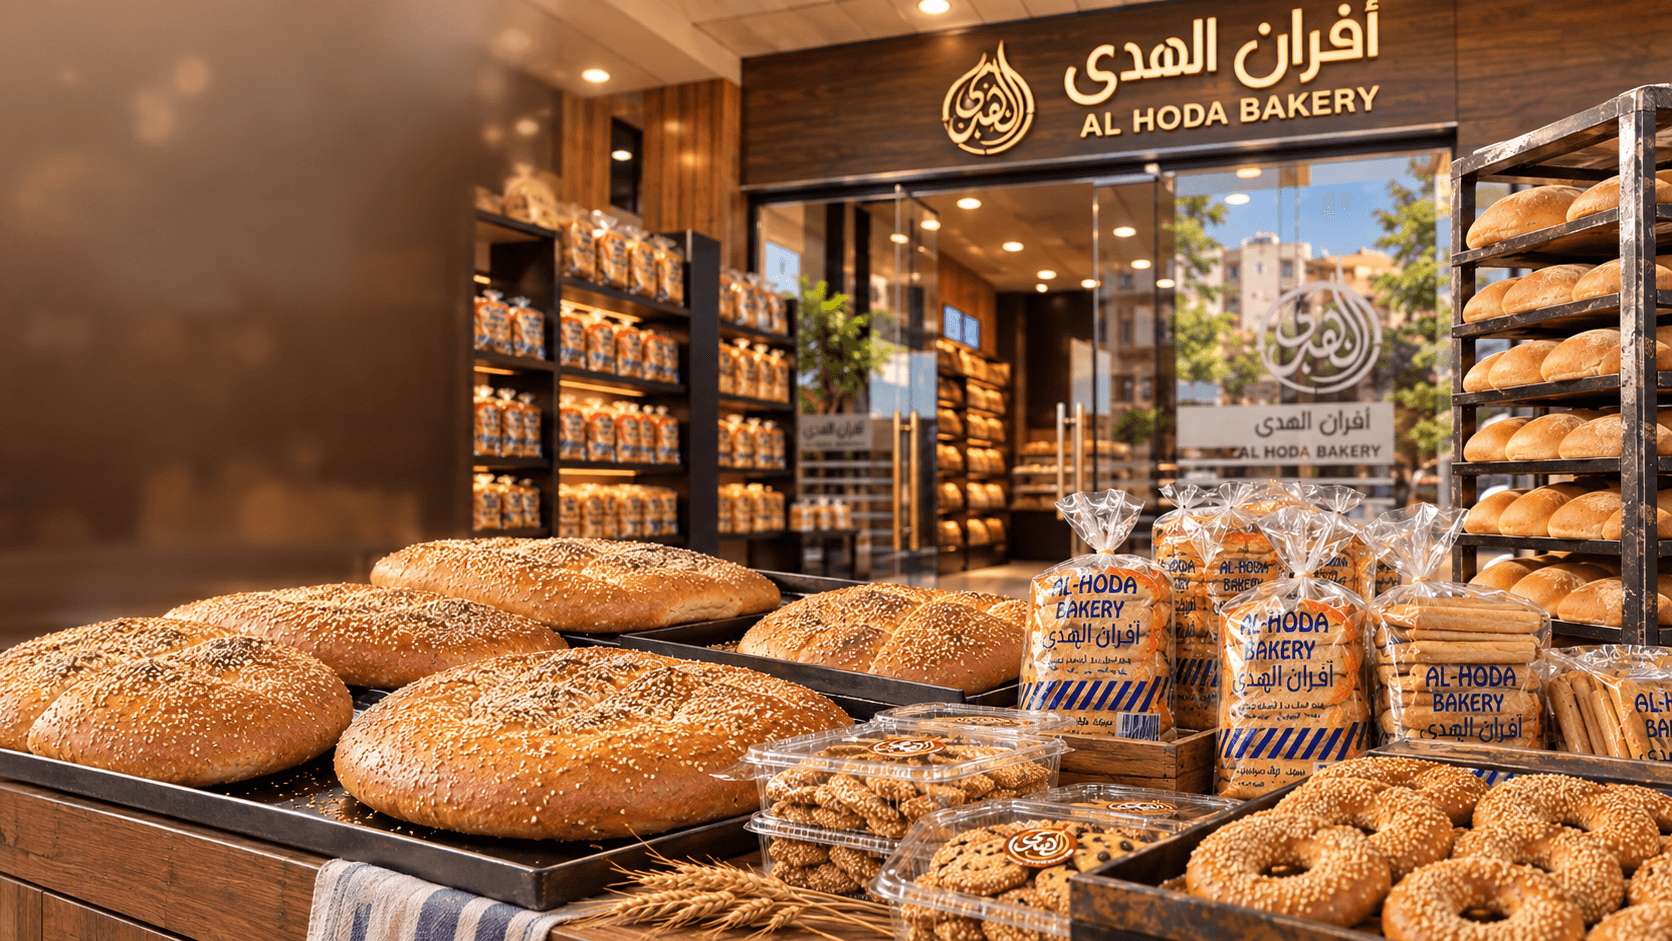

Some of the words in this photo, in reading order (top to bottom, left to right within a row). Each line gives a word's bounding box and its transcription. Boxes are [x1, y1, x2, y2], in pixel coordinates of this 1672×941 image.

[1233, 0, 1380, 89] أفران
[1063, 16, 1218, 106] الهدى
[1080, 112, 1122, 139] AL
[1132, 101, 1229, 133] HODA
[1239, 85, 1380, 123] BAKERY
[1254, 409, 1312, 438] الهدى
[1319, 406, 1371, 436] أفران
[1238, 445, 1260, 459] AL
[1264, 445, 1310, 459] HODA
[1316, 443, 1382, 459] BAKERY
[1051, 573, 1138, 597] AL-HODA
[1055, 599, 1125, 619] BAKERY
[1240, 610, 1329, 636] AL-HODA
[1244, 640, 1316, 662] BAKERY
[1425, 665, 1517, 688] AL-HODA
[1433, 693, 1504, 713] BAKERY
[1645, 718, 1672, 738] BA
